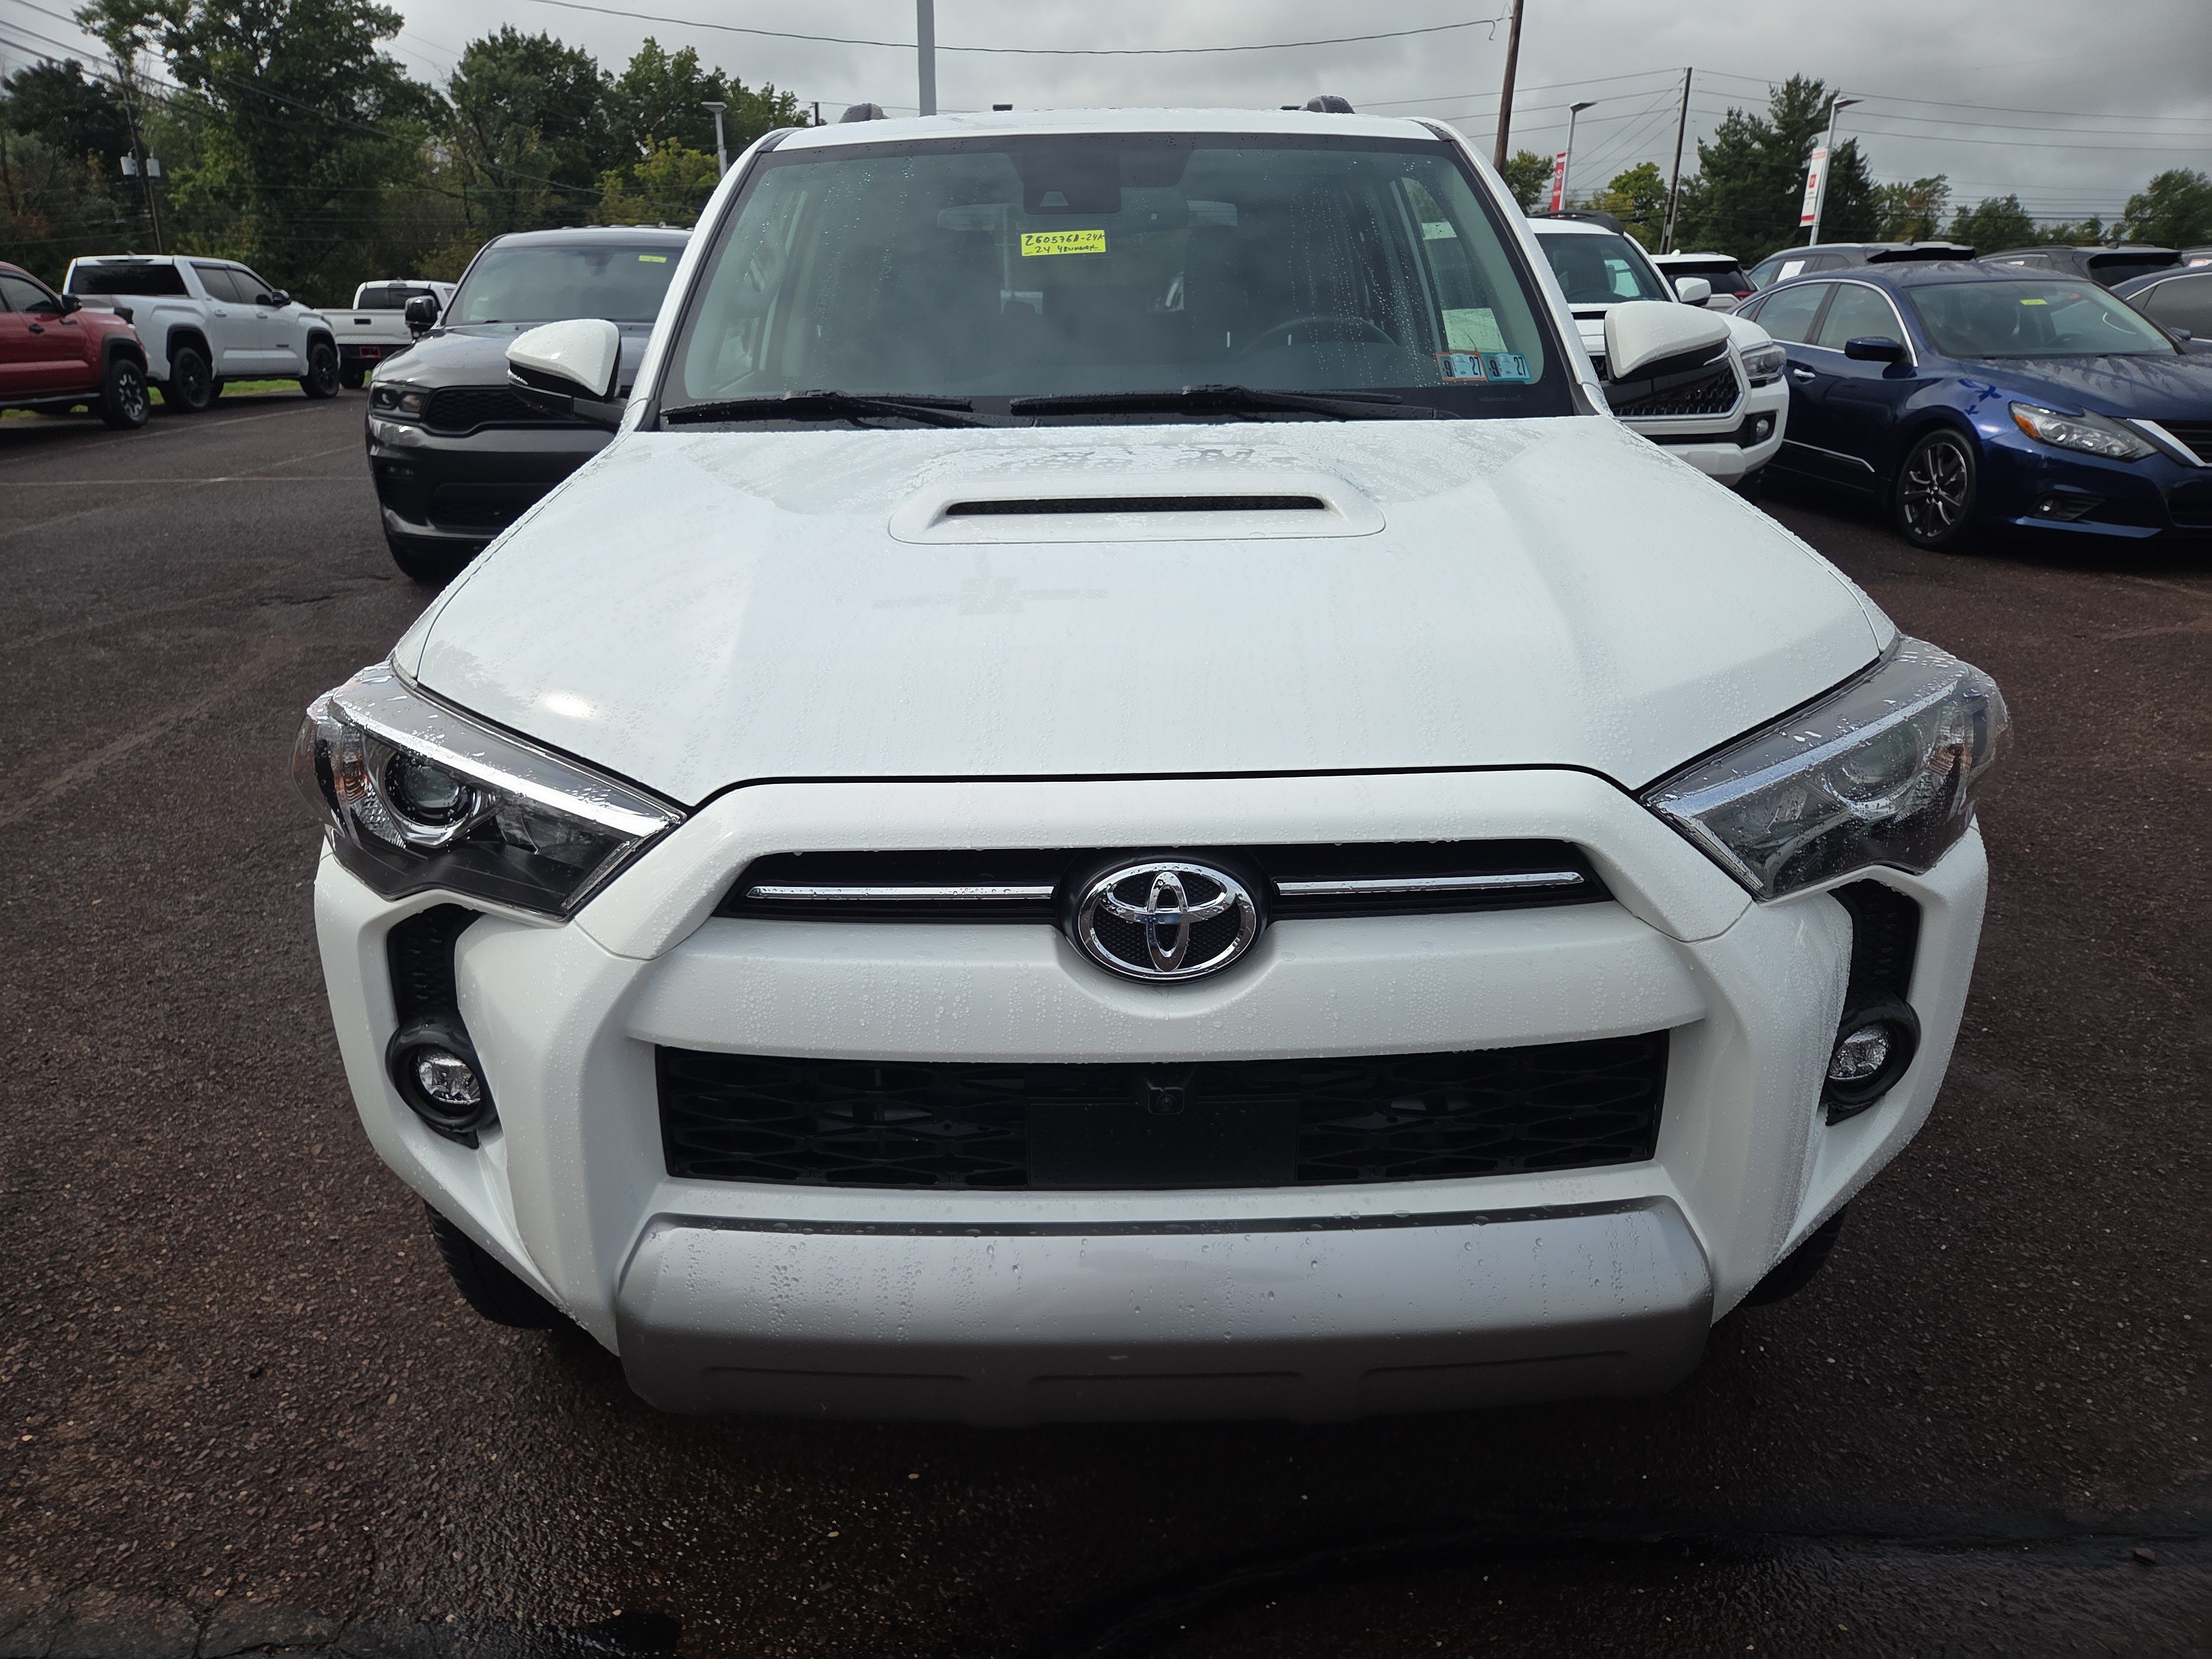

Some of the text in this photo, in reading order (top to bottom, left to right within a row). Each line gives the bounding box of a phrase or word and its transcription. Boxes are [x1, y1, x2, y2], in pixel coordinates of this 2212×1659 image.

[1443, 356, 1481, 377] 9 27
[1489, 356, 1526, 377] 9 27
